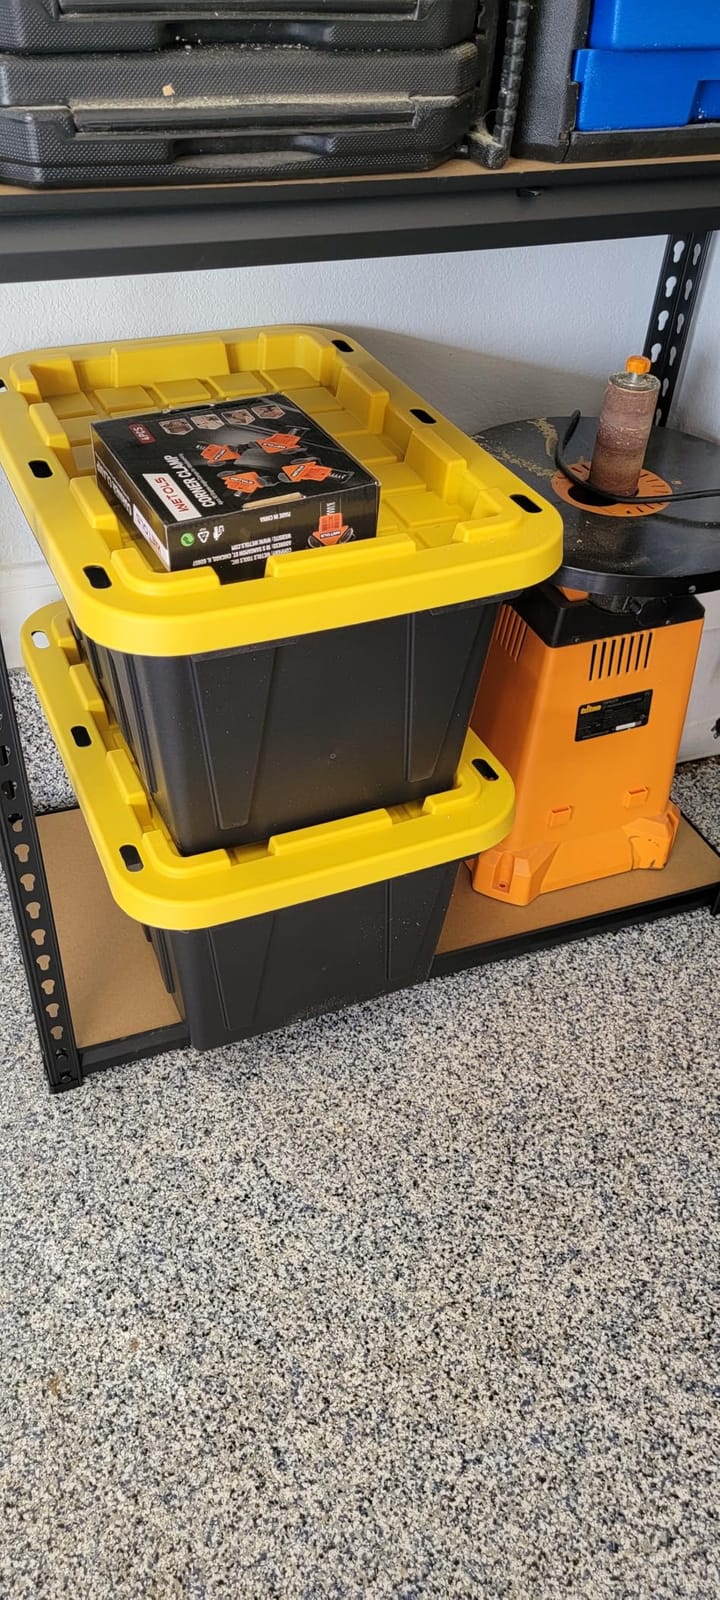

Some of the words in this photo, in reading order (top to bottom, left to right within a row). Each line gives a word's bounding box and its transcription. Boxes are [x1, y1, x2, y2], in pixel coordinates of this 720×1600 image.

[163, 455, 192, 478] CLAMP
[154, 477, 190, 512] WETOLS
[183, 478, 216, 507] CORNER
